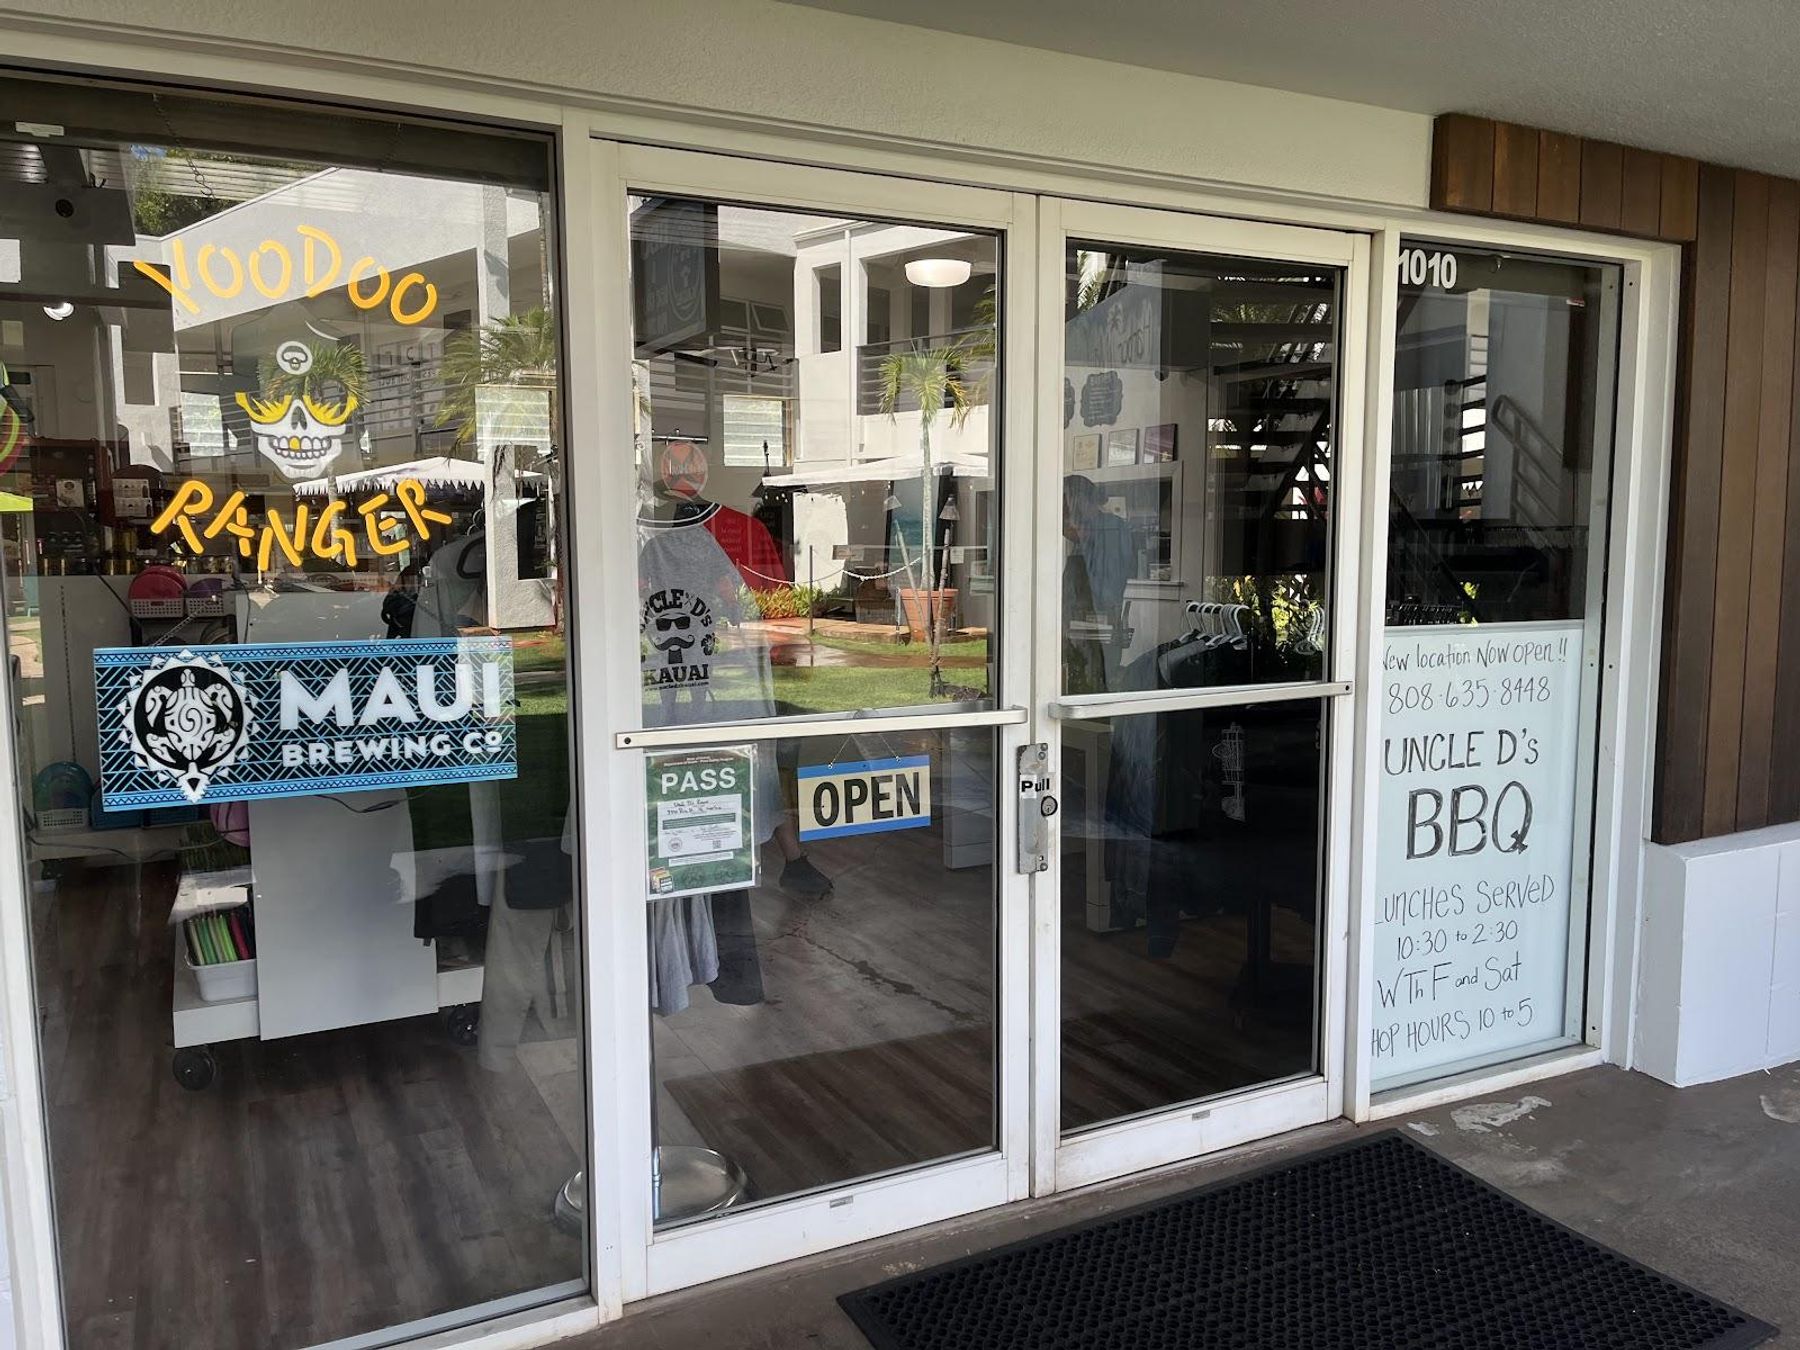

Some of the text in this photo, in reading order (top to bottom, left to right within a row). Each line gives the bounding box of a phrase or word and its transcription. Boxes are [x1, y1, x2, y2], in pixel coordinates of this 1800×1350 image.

[133, 225, 438, 324] VOODOO
[1399, 249, 1457, 289] 1010
[150, 480, 452, 571] RANGER
[643, 664, 709, 686] KAUAI
[1417, 643, 1470, 669] location
[279, 662, 501, 730] MAUI
[281, 734, 451, 768] BREWING
[1385, 728, 1539, 775] UNCLE D's
[661, 767, 736, 795] PASS
[813, 772, 920, 827] OPEN
[1021, 778, 1050, 792] Pull
[1406, 780, 1533, 860] BBQ
[1397, 920, 1518, 961] 10:30 to 2:30
[1455, 967, 1479, 988] and
[1485, 951, 1522, 991] Sat
[1407, 1010, 1470, 1052] HOURS
[1479, 1007, 1496, 1031] 10
[1502, 1007, 1514, 1020] to
[1517, 997, 1534, 1027] 5
